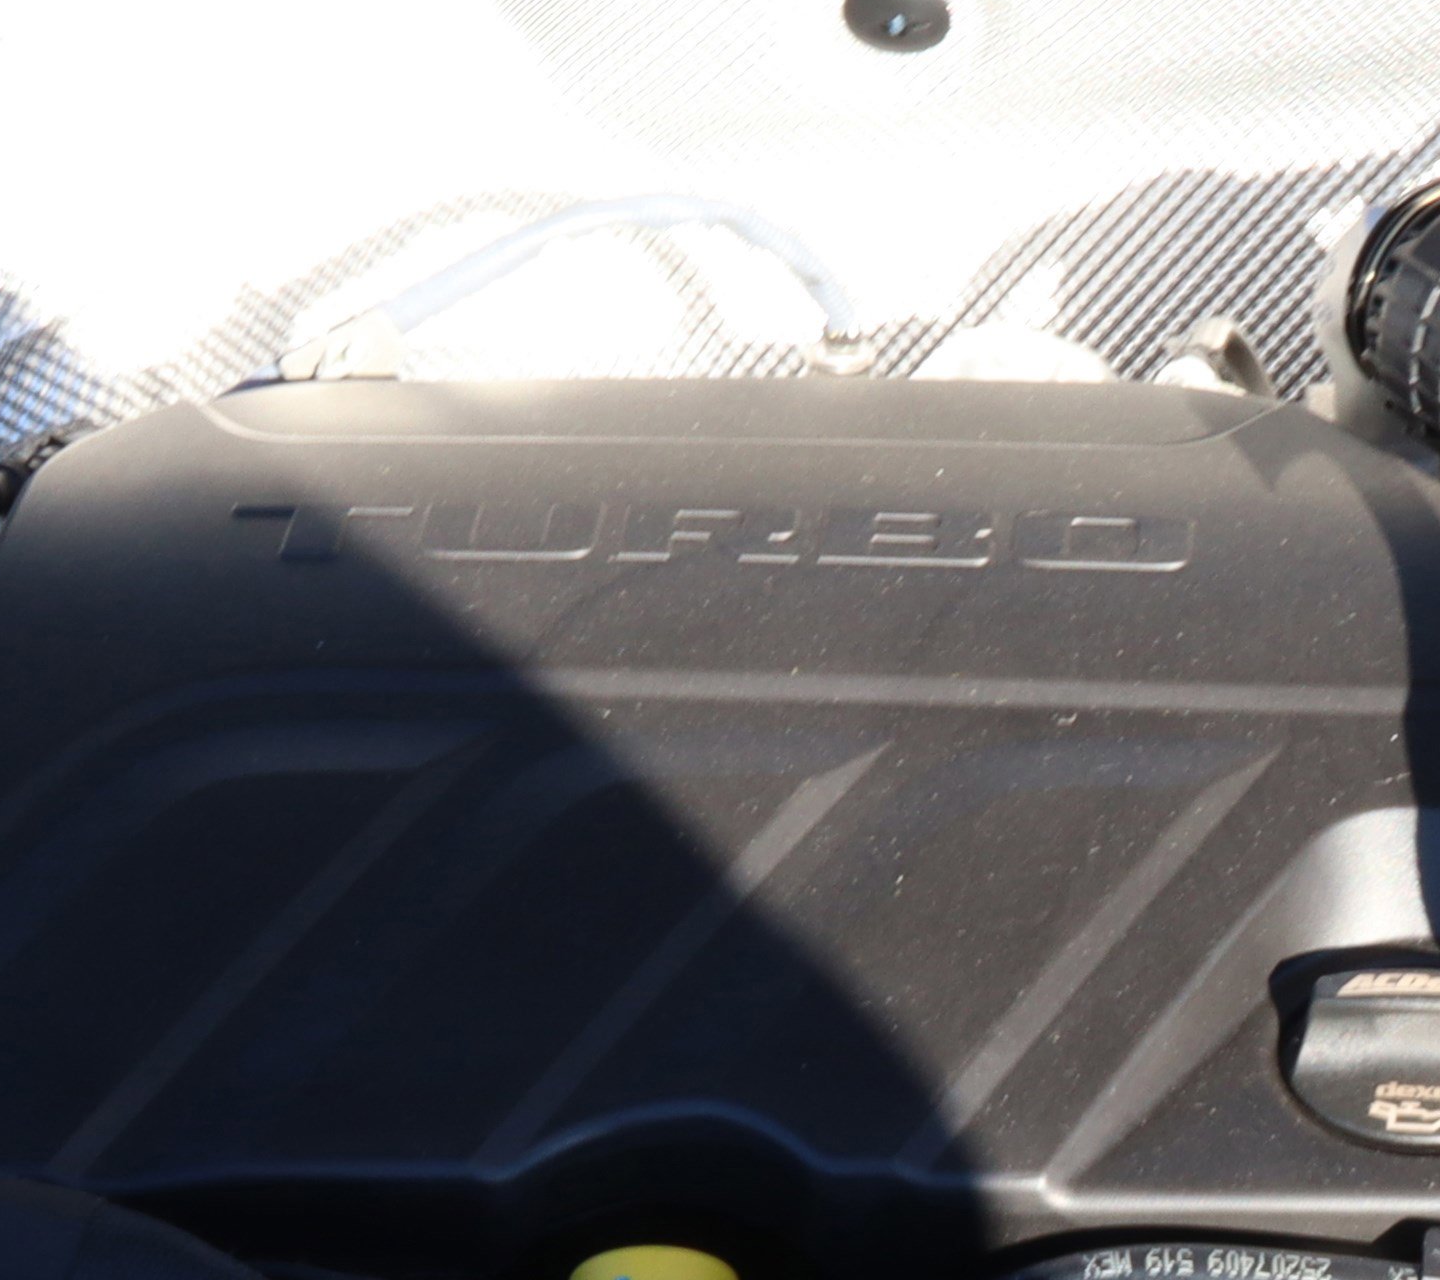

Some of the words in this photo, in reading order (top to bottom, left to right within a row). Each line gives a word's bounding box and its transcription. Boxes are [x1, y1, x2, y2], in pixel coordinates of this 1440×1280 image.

[230, 502, 1195, 574] TURBO
[1080, 1250, 1133, 1280] MEX
[1144, 1246, 1194, 1277] 519
